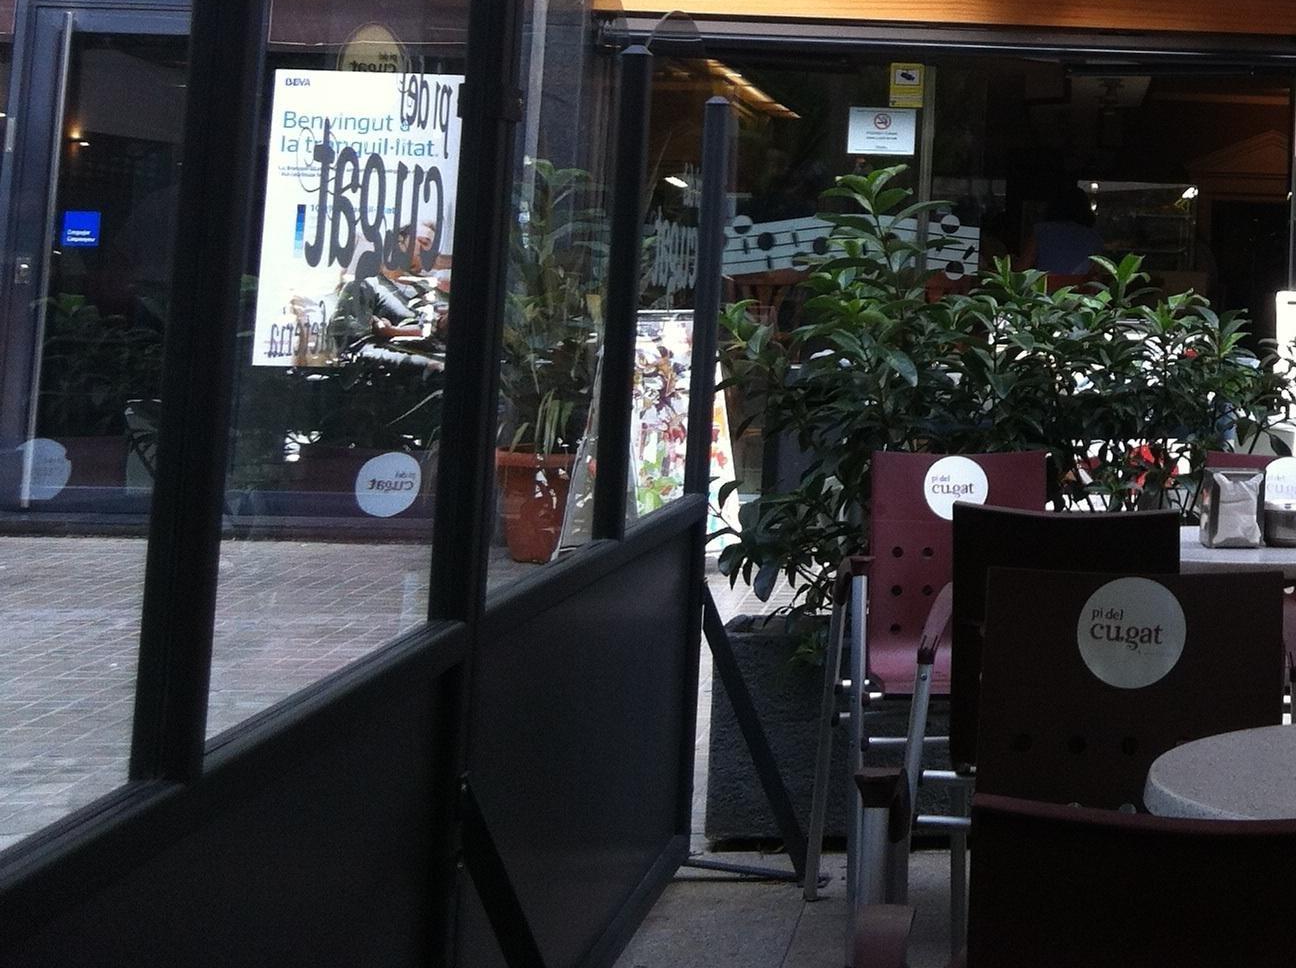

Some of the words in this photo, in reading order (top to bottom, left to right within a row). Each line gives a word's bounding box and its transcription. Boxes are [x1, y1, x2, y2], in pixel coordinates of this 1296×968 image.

[283, 111, 394, 135] Benvingut
[280, 135, 299, 153] la
[931, 483, 974, 499] cugat
[1091, 608, 1103, 621] pi
[1105, 608, 1124, 621] del
[1090, 623, 1163, 651] cugat
